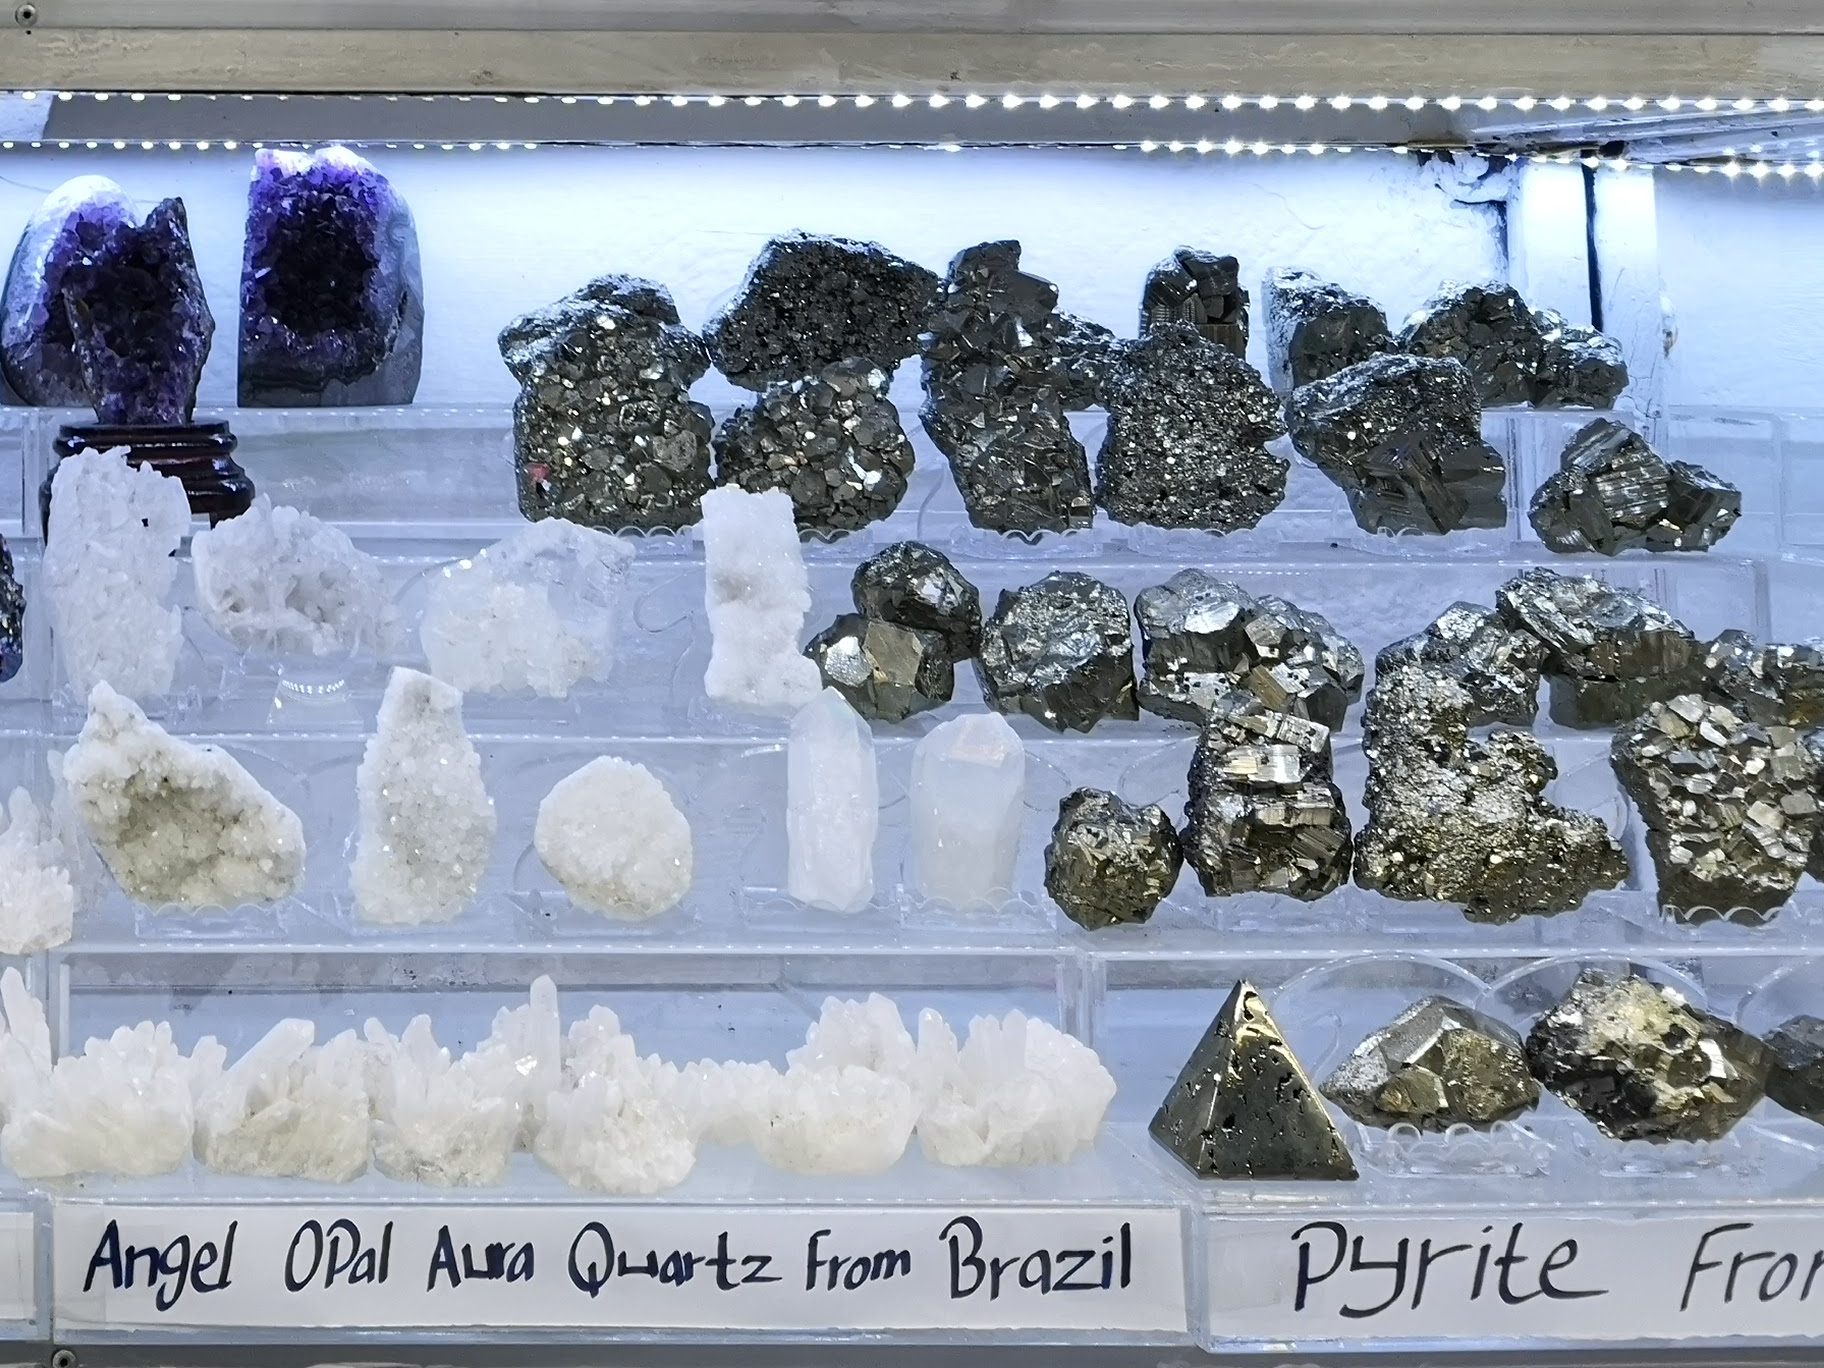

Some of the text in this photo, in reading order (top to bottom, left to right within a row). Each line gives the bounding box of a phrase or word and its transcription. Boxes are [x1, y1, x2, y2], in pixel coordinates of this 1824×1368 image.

[82, 1219, 239, 1312] Angel
[426, 1224, 535, 1293] Aura
[567, 1221, 783, 1299] Quartz
[805, 1228, 912, 1292] From
[938, 1215, 1132, 1302] Brazil
[1290, 1220, 1609, 1319] Pyrite
